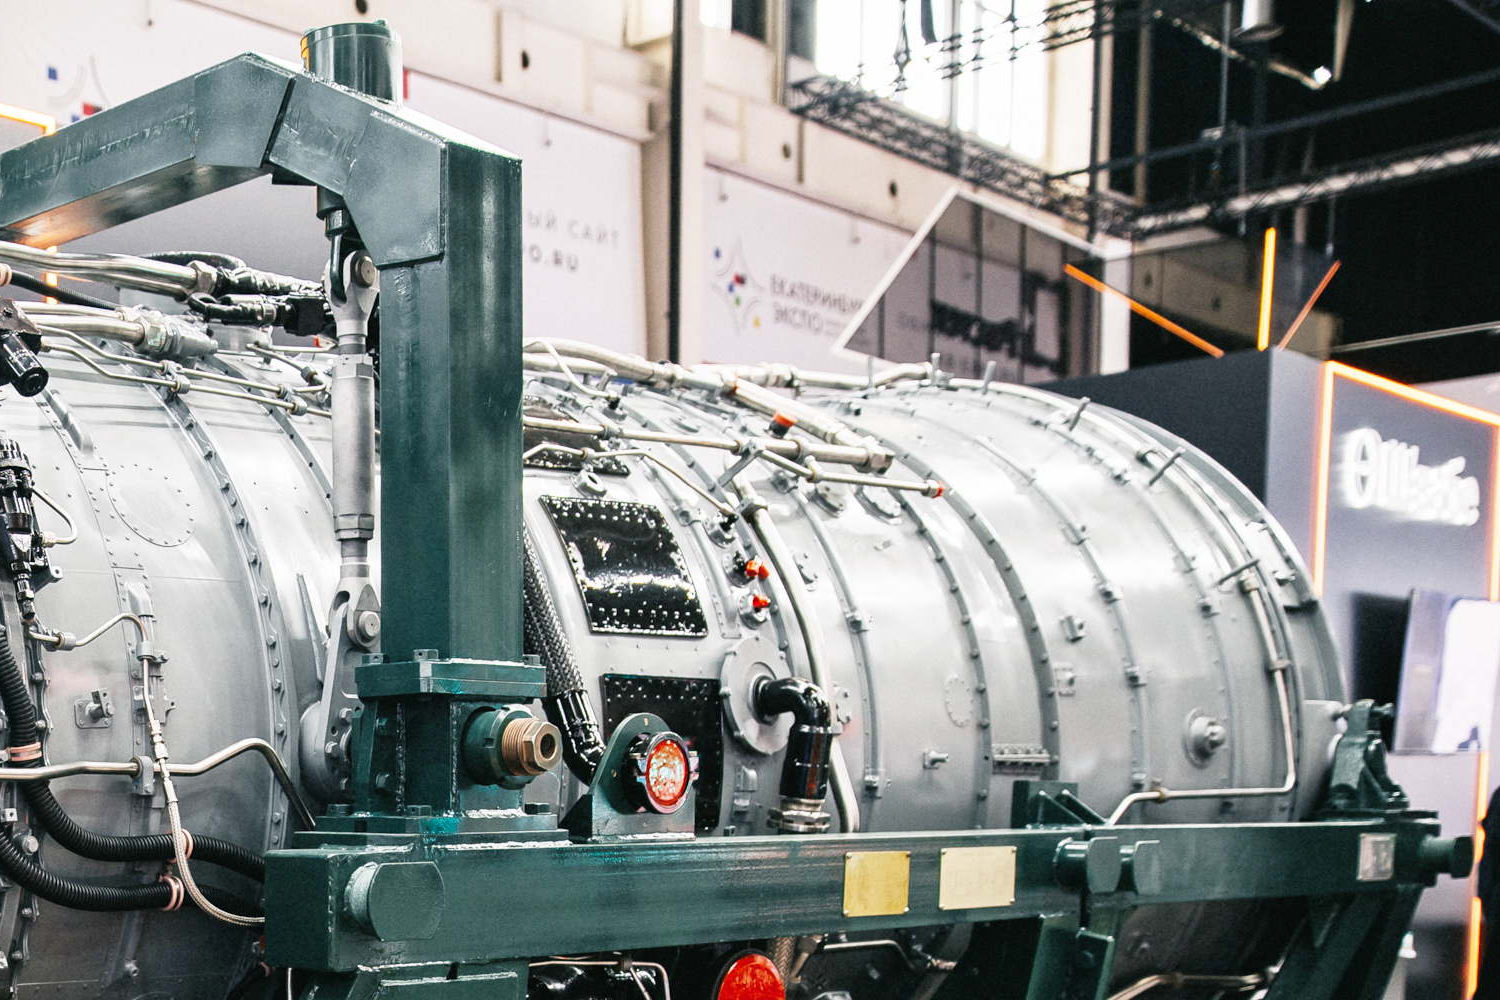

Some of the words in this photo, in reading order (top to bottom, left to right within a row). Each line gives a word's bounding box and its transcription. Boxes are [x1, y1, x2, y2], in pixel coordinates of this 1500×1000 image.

[526, 209, 557, 230] ЫЙ
[567, 219, 619, 248] САЙТ
[522, 244, 579, 273] O.RU
[770, 274, 865, 315] ЕКАТЕРИНБУР
[773, 301, 824, 335] ЭКСПО
